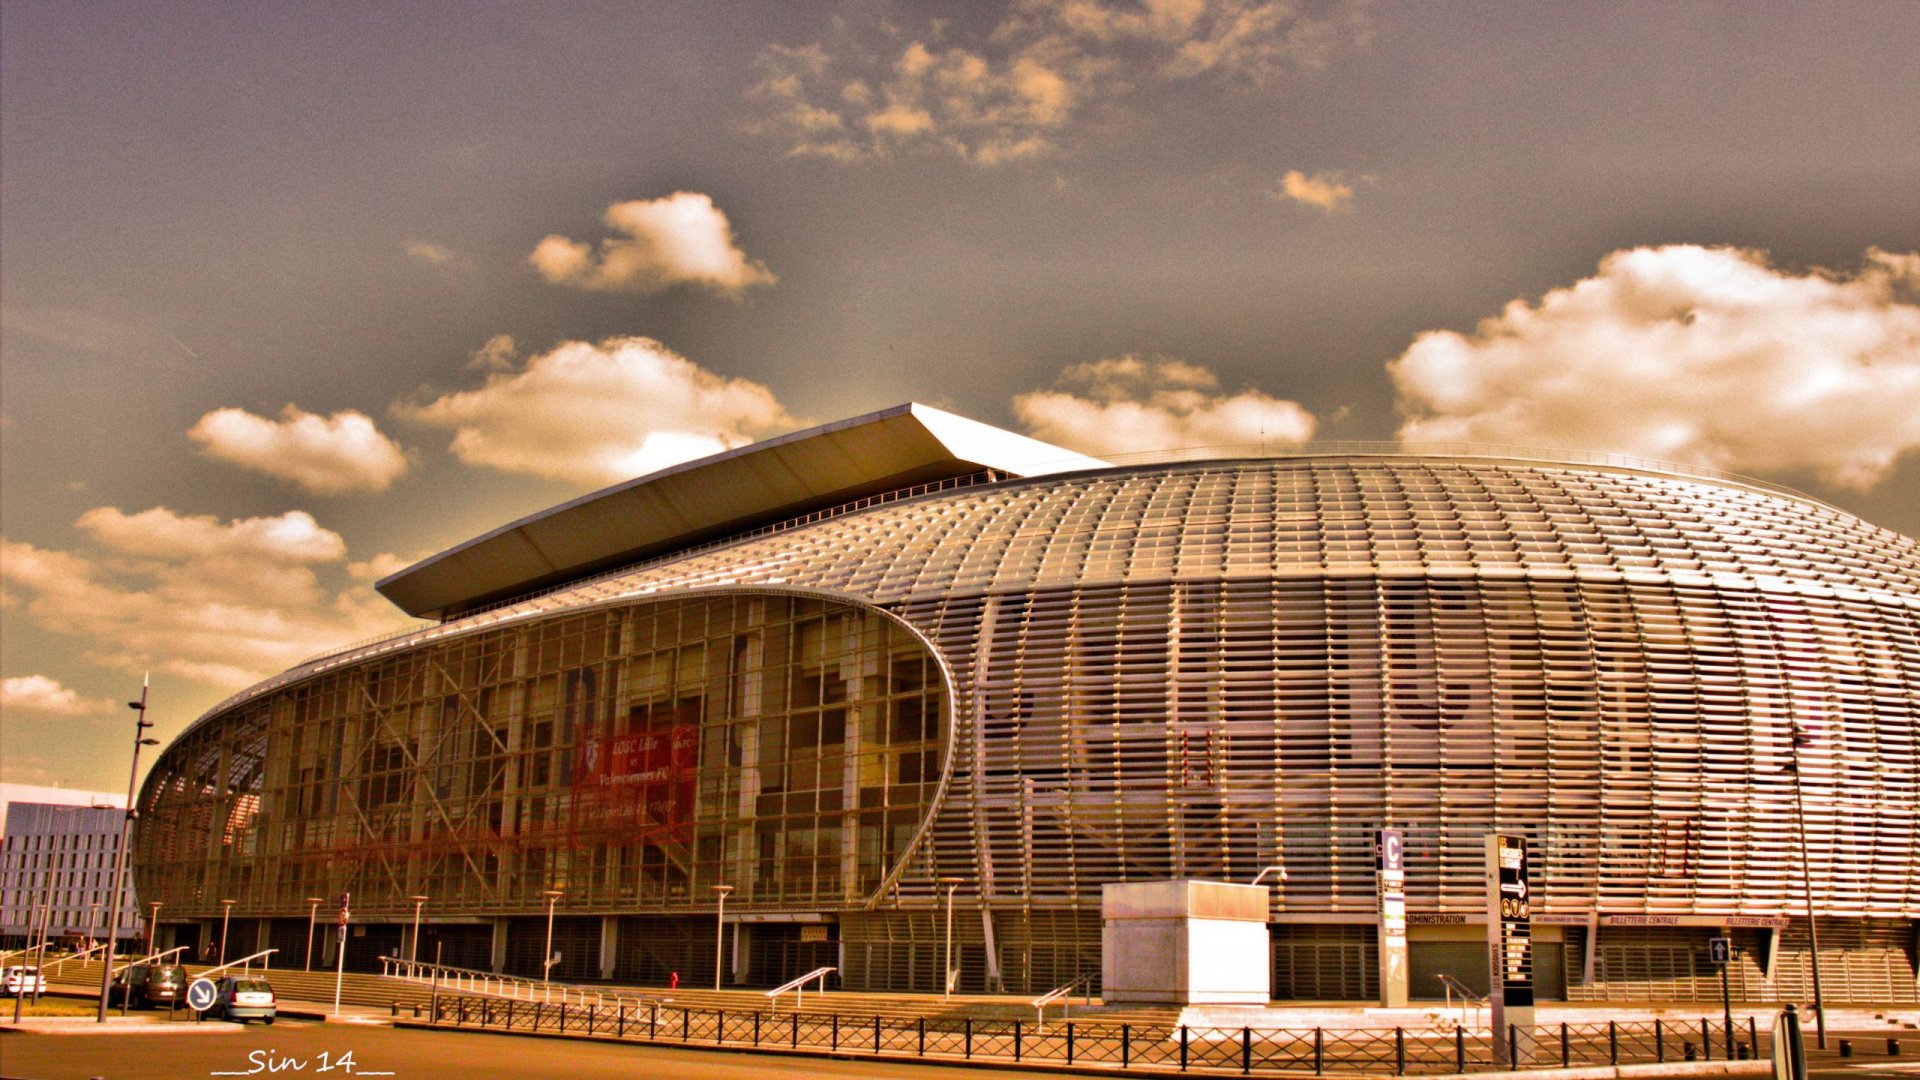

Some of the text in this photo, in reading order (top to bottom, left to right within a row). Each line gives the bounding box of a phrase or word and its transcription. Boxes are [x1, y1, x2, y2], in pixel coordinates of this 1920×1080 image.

[613, 736, 659, 755] LOSC Lille
[600, 766, 670, 785] Valenciennes FC
[1387, 836, 1398, 862] C
[1405, 915, 1466, 924] ADMINISTRATION
[1610, 916, 1678, 925] BILLETTERIE CENTRALE
[1726, 917, 1789, 927] BILLETTERIE CENTRALE
[1491, 943, 1499, 976] KIOSQUES
